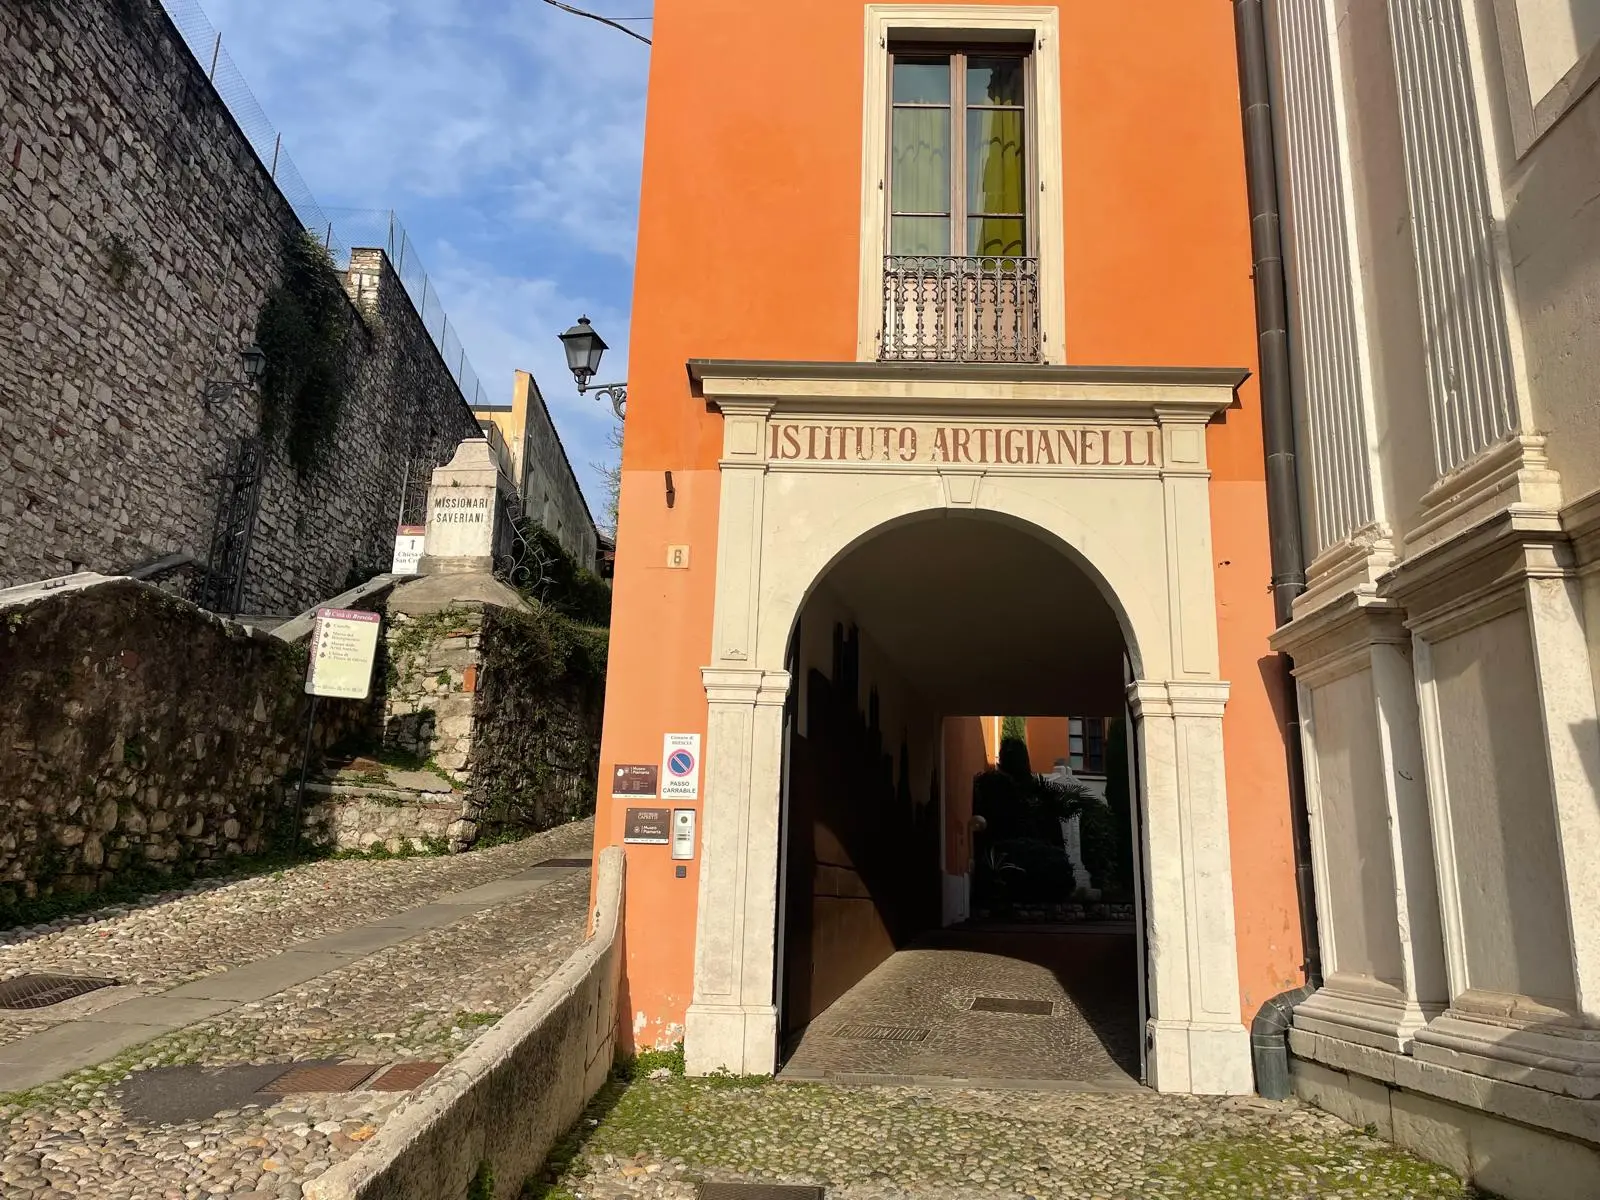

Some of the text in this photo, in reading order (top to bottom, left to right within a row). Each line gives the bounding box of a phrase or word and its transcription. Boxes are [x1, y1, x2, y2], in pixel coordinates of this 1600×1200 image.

[769, 424, 1156, 466] ISTITUTO ARTIGIANELLI
[434, 498, 488, 509] MISSIONARI
[436, 513, 484, 523] SAVERIANI
